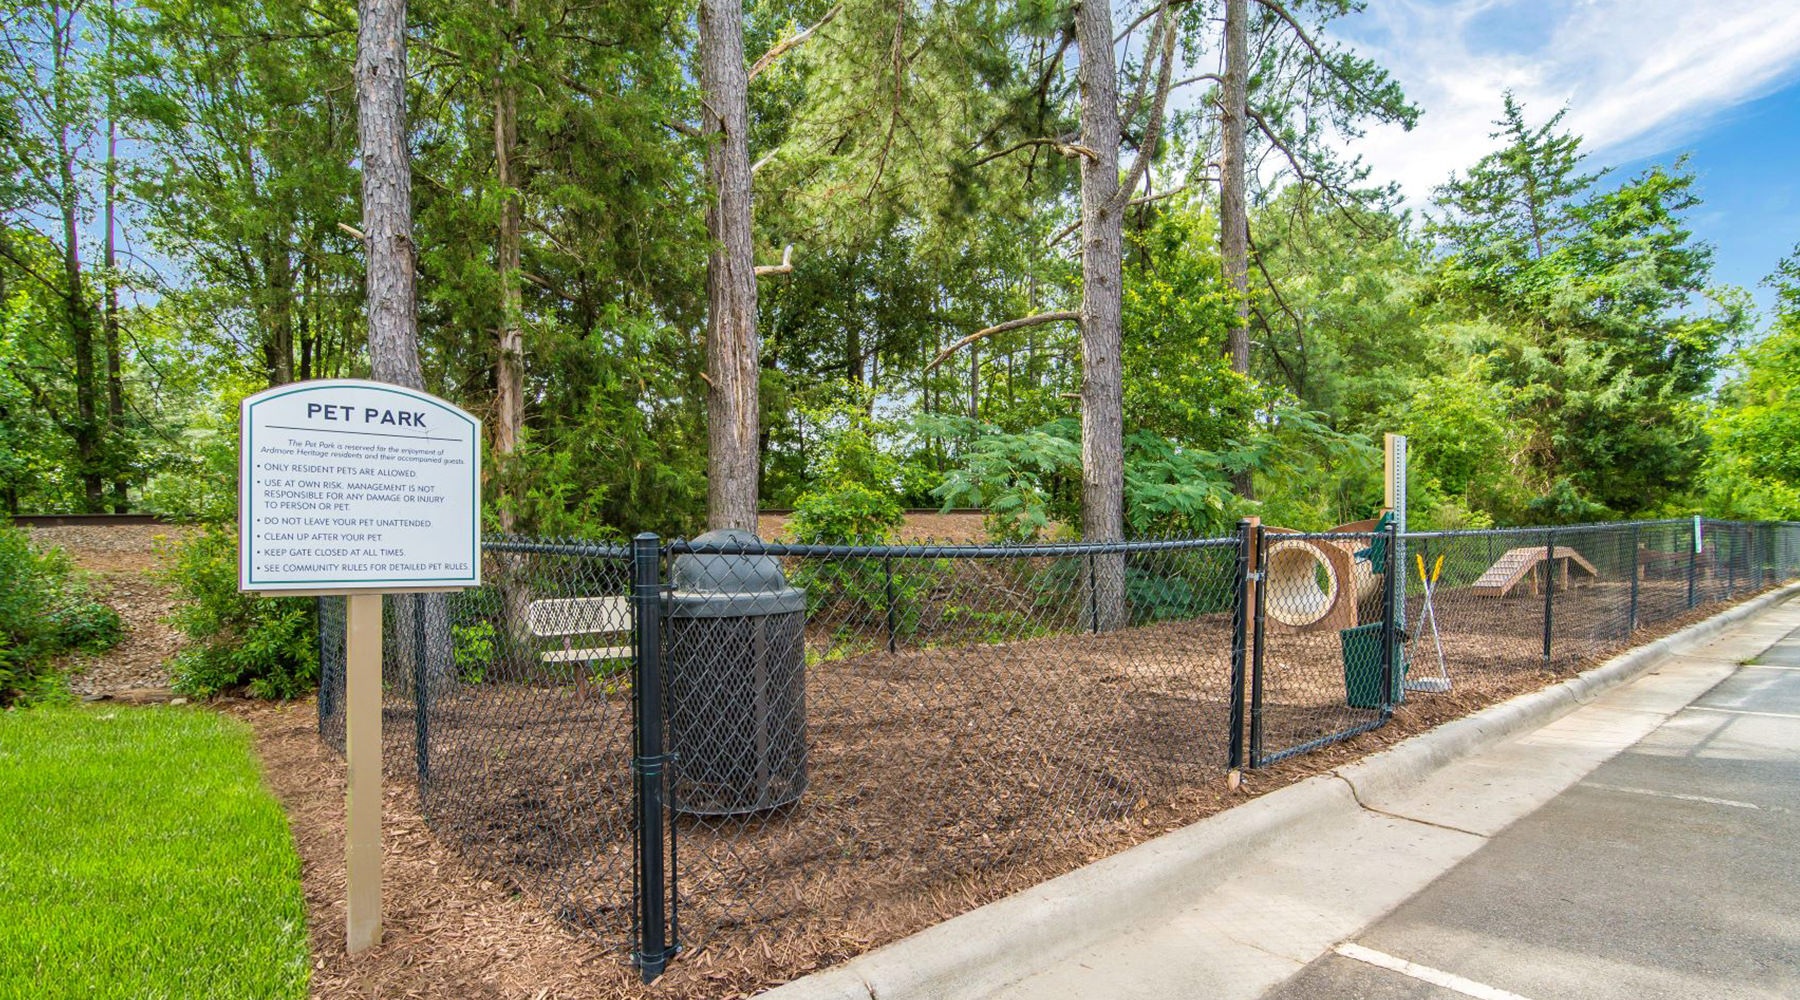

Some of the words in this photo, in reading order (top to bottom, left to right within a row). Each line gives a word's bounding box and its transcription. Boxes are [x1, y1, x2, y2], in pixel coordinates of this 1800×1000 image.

[307, 403, 355, 421] PET
[365, 408, 427, 428] PARK
[305, 440, 317, 448] Pet
[319, 441, 335, 449] Park
[345, 443, 375, 452] reserved
[401, 448, 436, 457] enjoyment
[261, 446, 295, 455] Ardmore
[297, 448, 329, 458] Heritage
[331, 451, 363, 459] residents
[380, 453, 396, 461] their
[397, 456, 442, 465] accompanied
[264, 463, 289, 472] ONLY
[292, 464, 335, 474] RESIDENT
[337, 467, 358, 475] PETS
[359, 468, 375, 476] ARE
[264, 479, 282, 487] USE
[284, 480, 296, 488] AT
[298, 480, 321, 489] OWN
[347, 482, 407, 492] MANAGEMENT
[408, 484, 416, 492] IS
[418, 485, 436, 493] NOT
[264, 490, 324, 500] RESPONSIBLE
[326, 492, 344, 500] FOR
[346, 493, 364, 501] ANY
[366, 493, 401, 502] DAMAGE
[403, 495, 416, 503] OR
[265, 501, 279, 509] TO
[280, 501, 317, 511] PERSON
[318, 503, 332, 511] OR
[264, 517, 280, 525] DO
[281, 517, 302, 525] NOT
[304, 518, 330, 526] LEAVE
[332, 518, 357, 526] YOUR
[359, 519, 374, 527] PET
[264, 532, 294, 541] CLEAN
[297, 533, 310, 541] UP
[311, 533, 339, 541] AFTER
[341, 533, 365, 541] YOUR
[264, 548, 287, 557] KEEP
[289, 548, 313, 557] GATE
[314, 548, 349, 557] CLOSED
[350, 548, 361, 557] AT
[362, 548, 378, 557] ALL
[264, 564, 280, 573] SEE
[282, 563, 340, 573] COMMUNITY
[342, 563, 368, 572] RULES
[370, 563, 387, 571] FOR
[389, 563, 426, 571] DETAILED
[428, 563, 442, 571] PET
